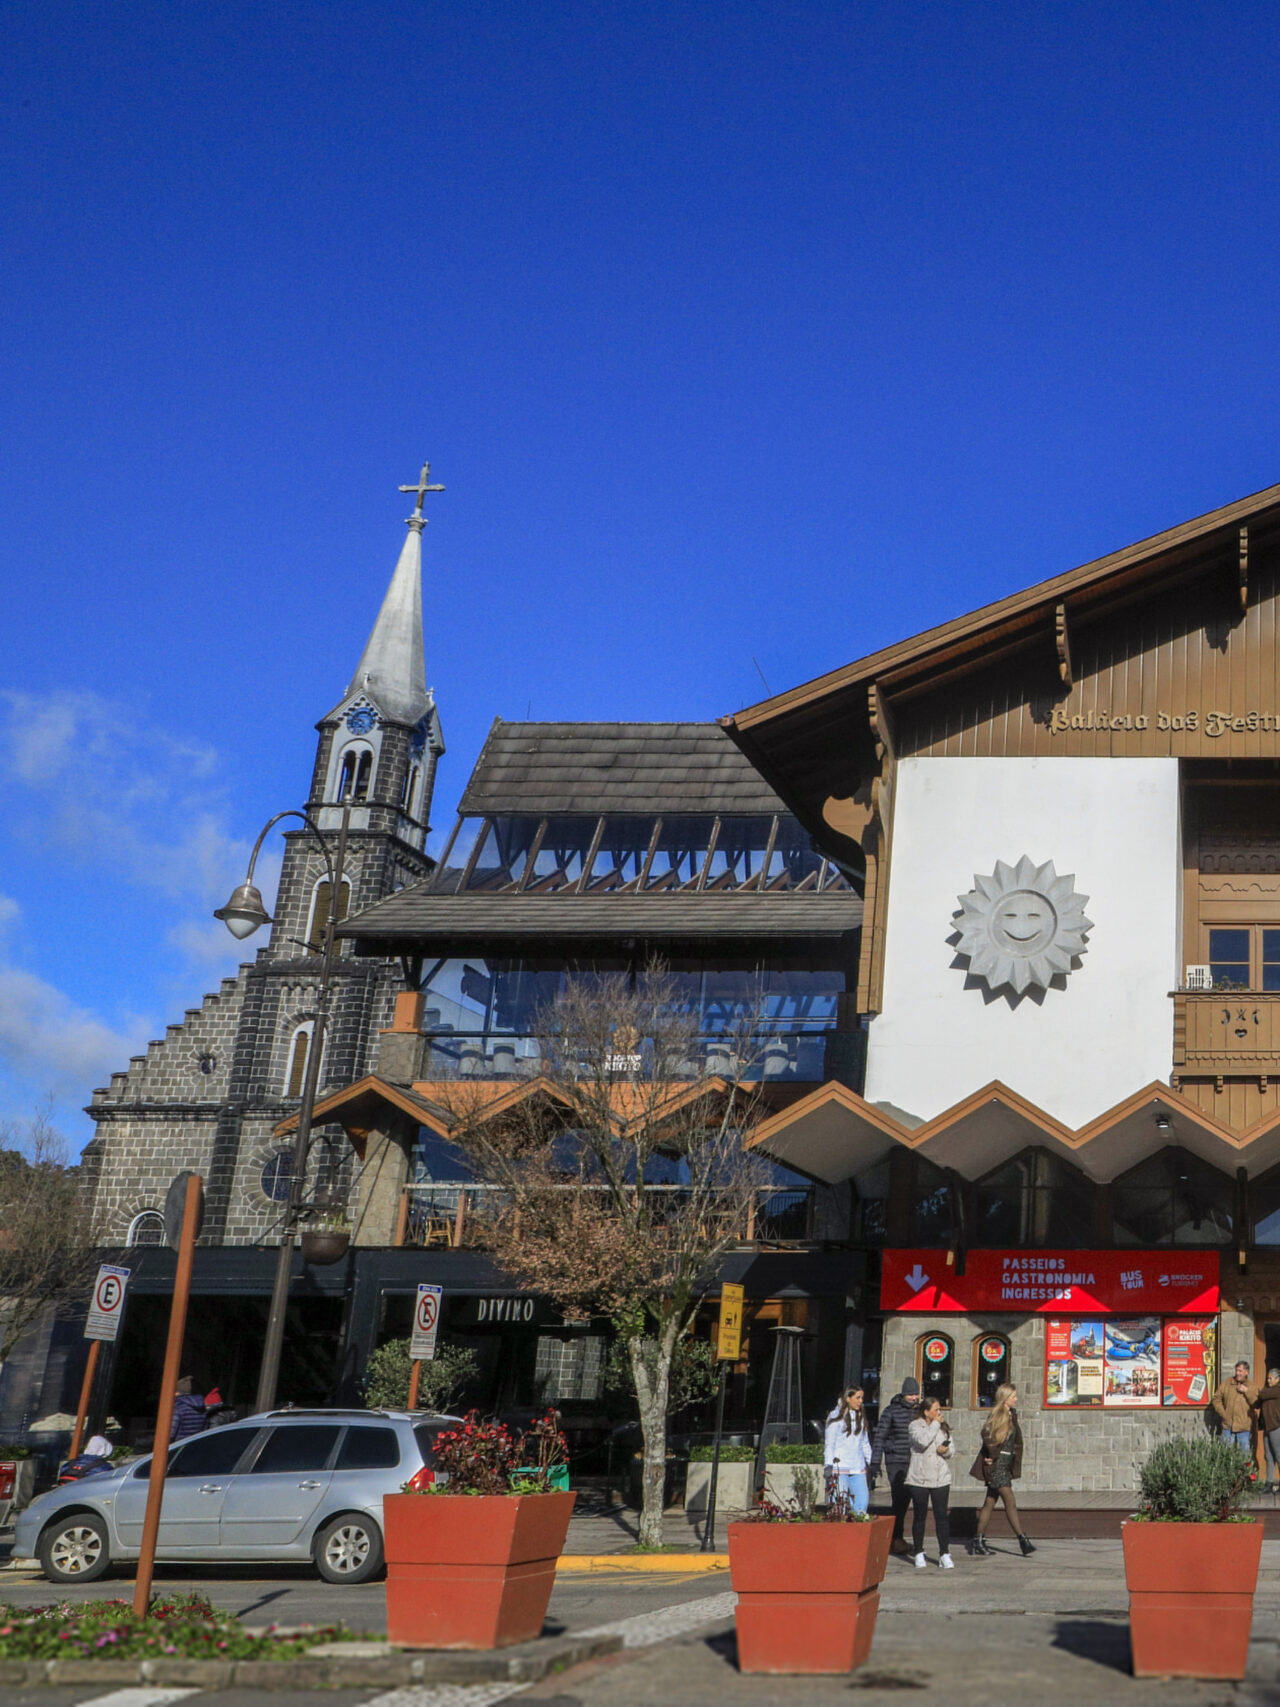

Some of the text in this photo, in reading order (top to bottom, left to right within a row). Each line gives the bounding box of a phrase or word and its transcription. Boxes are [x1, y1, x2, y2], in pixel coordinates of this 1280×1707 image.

[1156, 710, 1200, 732] dos
[1003, 1258, 1065, 1270] PASSEIOS
[1002, 1273, 1096, 1285] GASTRONOMIA
[1120, 1270, 1143, 1282] BUS
[1122, 1279, 1145, 1291] TOUR
[103, 1283, 115, 1305] E
[1002, 1287, 1072, 1300] INGRESSOS
[477, 1299, 534, 1321] DIVINO
